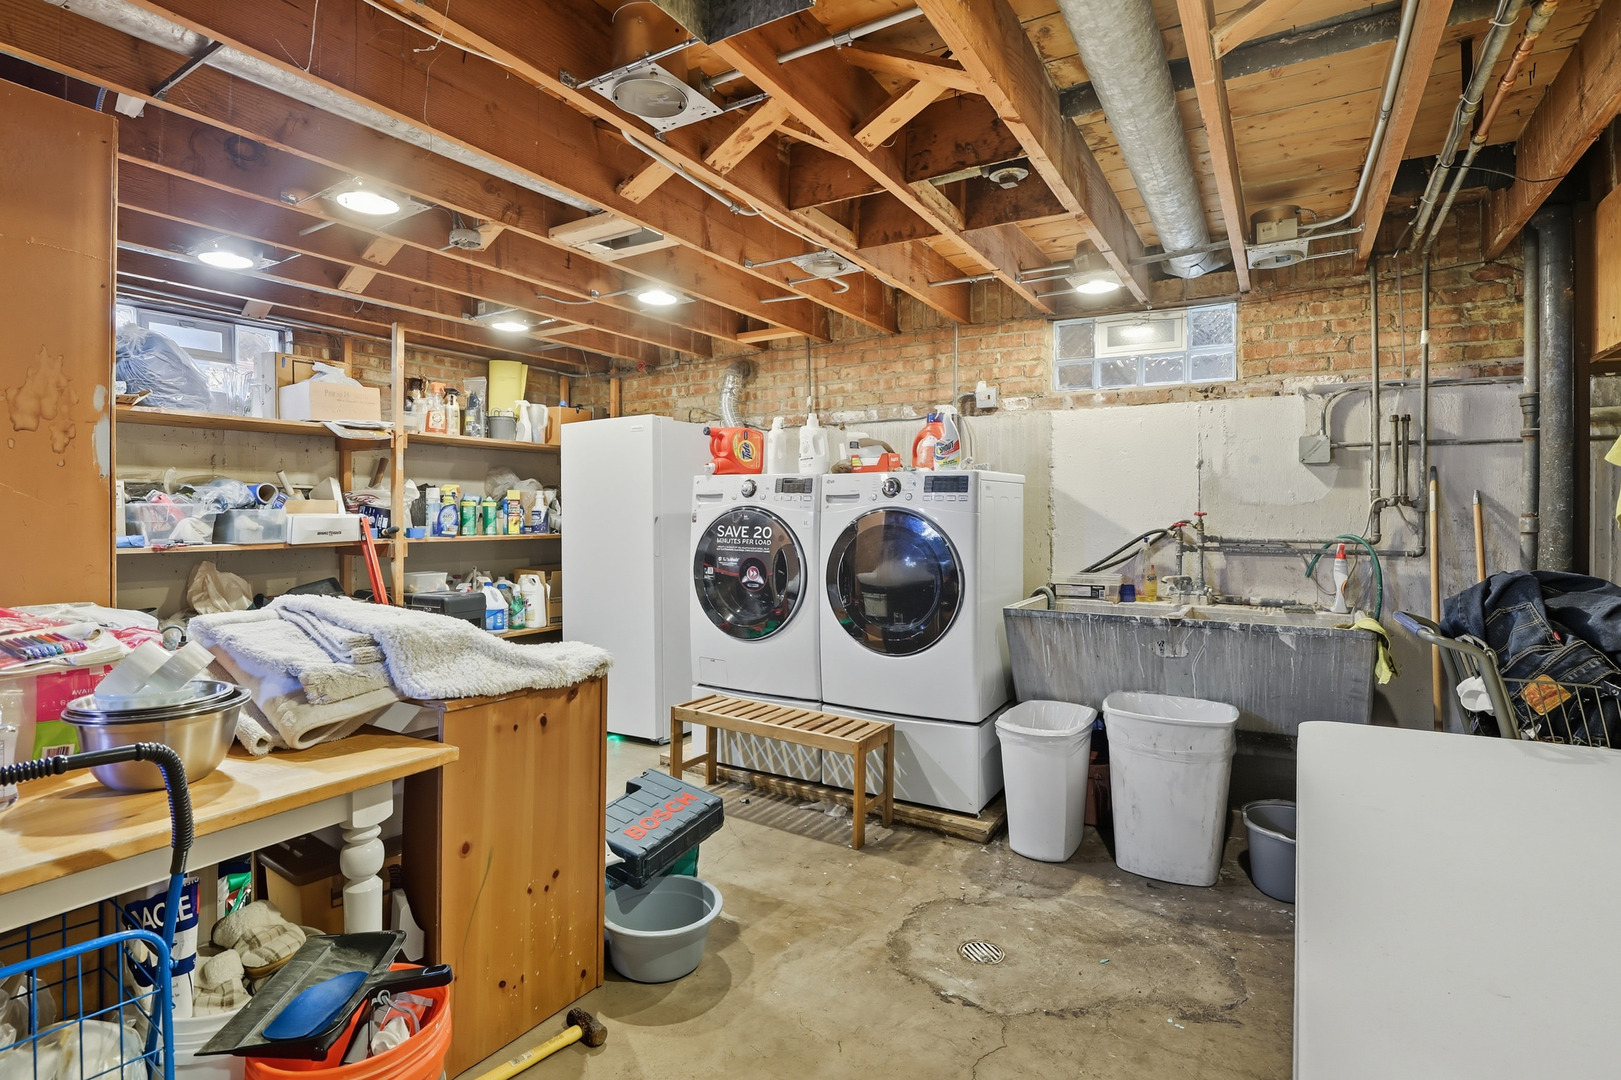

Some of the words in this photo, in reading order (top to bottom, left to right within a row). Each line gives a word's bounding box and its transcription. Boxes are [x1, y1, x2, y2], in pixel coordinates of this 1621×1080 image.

[742, 442, 753, 460] Tide
[717, 525, 750, 538] SAVE
[753, 526, 772, 539] 20
[716, 537, 741, 545] MINUTES
[623, 792, 698, 840] BOSCH
